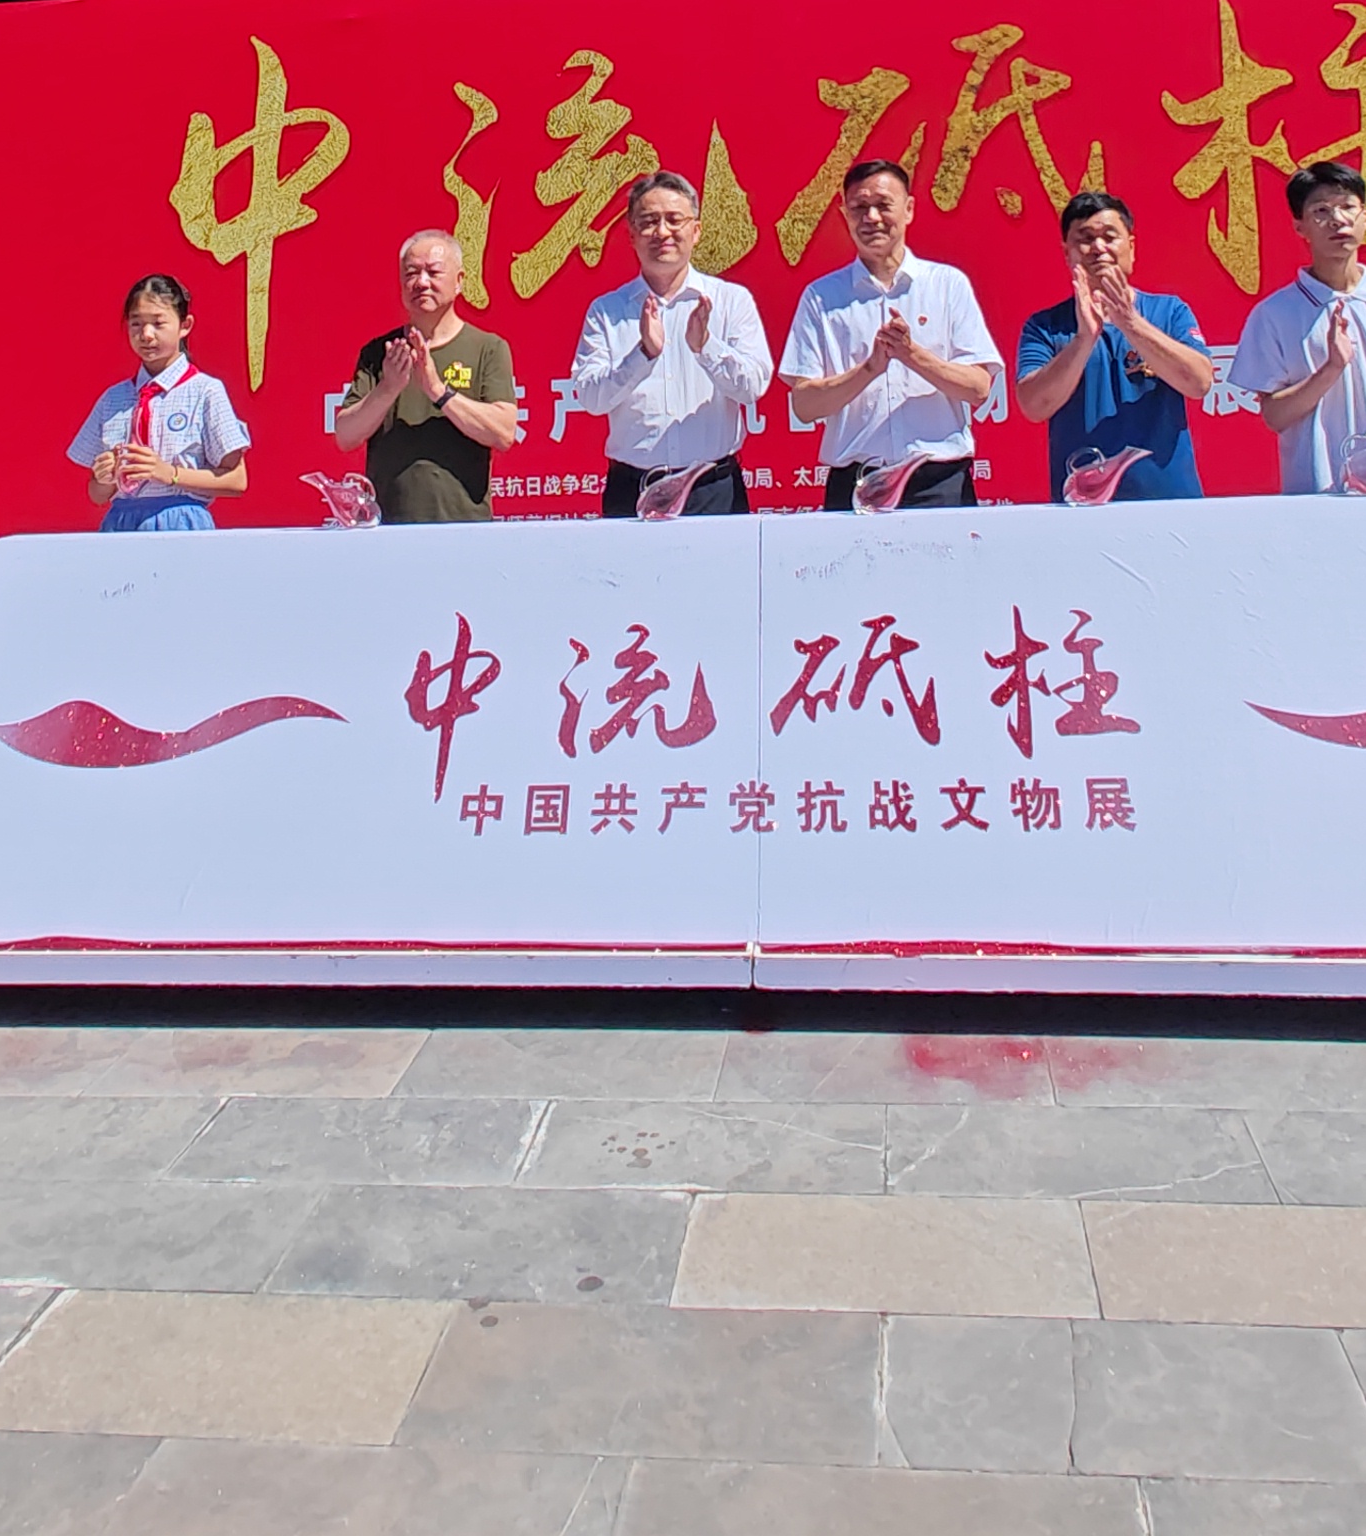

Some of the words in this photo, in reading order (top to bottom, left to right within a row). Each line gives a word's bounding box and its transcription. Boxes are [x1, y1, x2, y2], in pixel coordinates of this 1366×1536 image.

[443, 365, 473, 380] 中国
[972, 459, 992, 481] 局
[404, 605, 1142, 802] 中流砥柱
[460, 777, 1138, 838] 中国共产党抗战文物展
